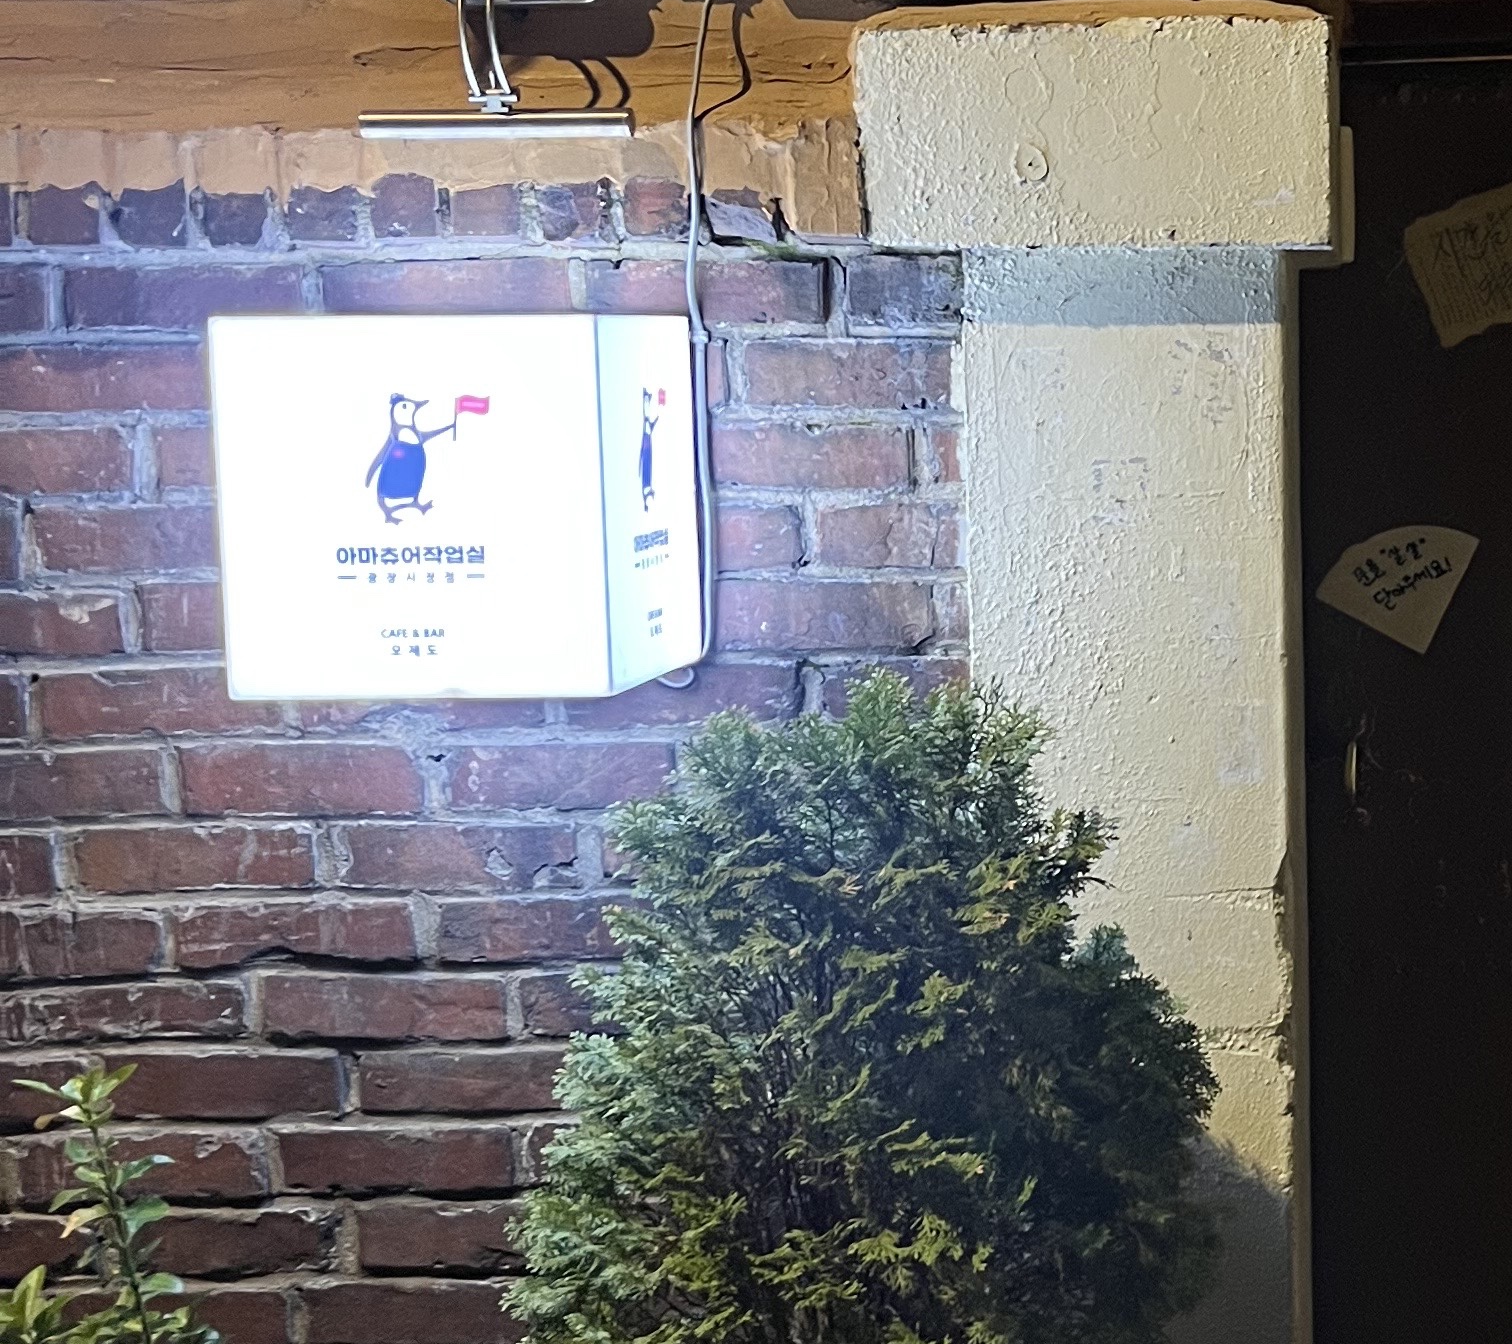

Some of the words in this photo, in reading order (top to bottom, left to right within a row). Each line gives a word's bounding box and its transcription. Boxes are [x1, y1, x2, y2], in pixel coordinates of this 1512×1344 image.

[335, 545, 486, 566] 아마츄어작업실
[380, 629, 409, 639] CAFE
[412, 629, 420, 638] &
[423, 629, 445, 638] BAR
